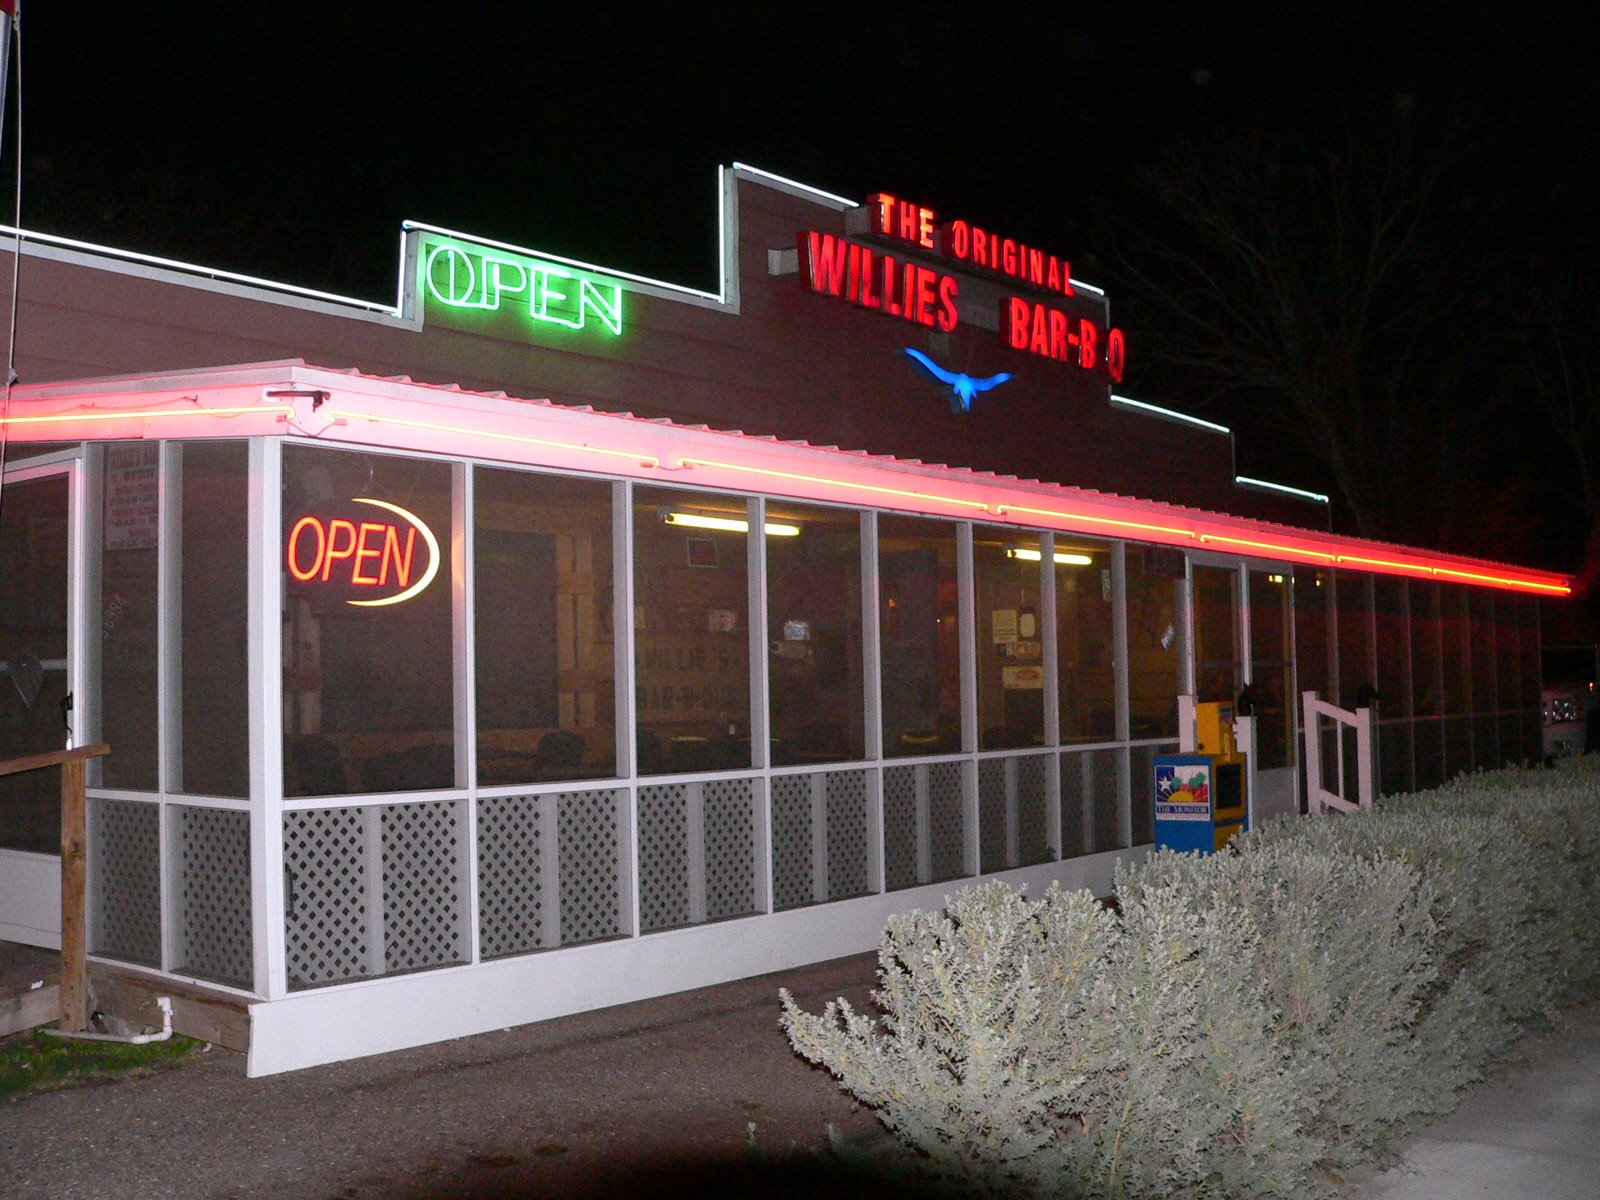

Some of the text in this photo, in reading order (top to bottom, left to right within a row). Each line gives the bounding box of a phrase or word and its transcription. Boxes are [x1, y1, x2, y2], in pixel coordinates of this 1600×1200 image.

[426, 244, 622, 335] OPEN
[806, 230, 959, 332] WILLIES
[873, 192, 1075, 297] THE ORIGINAL
[287, 515, 417, 588] OPEN
[1158, 805, 1208, 814] THE MONITOR
